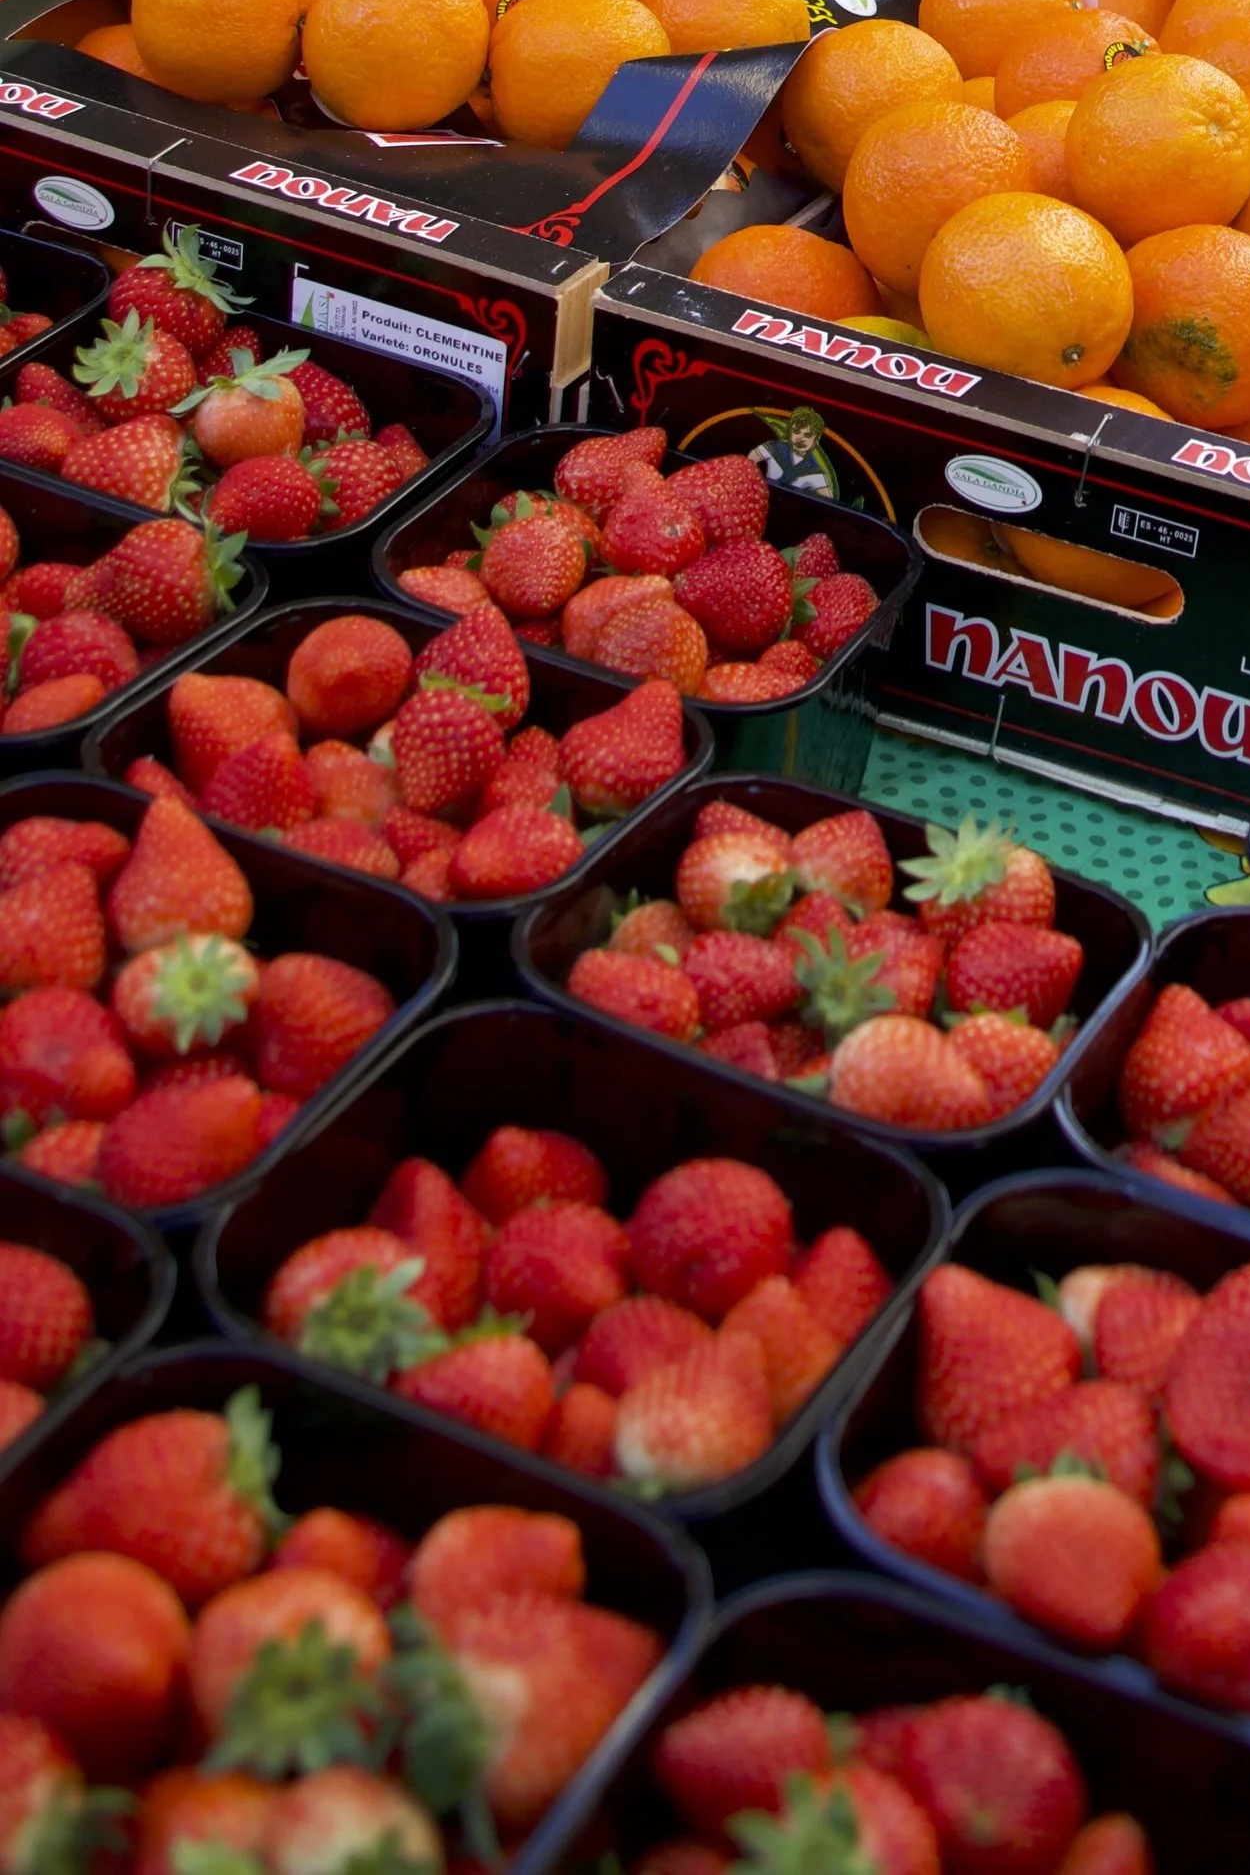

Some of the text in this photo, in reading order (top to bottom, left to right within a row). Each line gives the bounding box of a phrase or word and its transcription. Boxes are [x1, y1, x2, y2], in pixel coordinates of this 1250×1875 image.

[37, 191, 64, 208] SALA
[361, 310, 413, 334] Produit:
[415, 326, 504, 363] CLEMENTINE
[361, 328, 484, 375] Varieté: ORONULES
[953, 471, 984, 488] SALA
